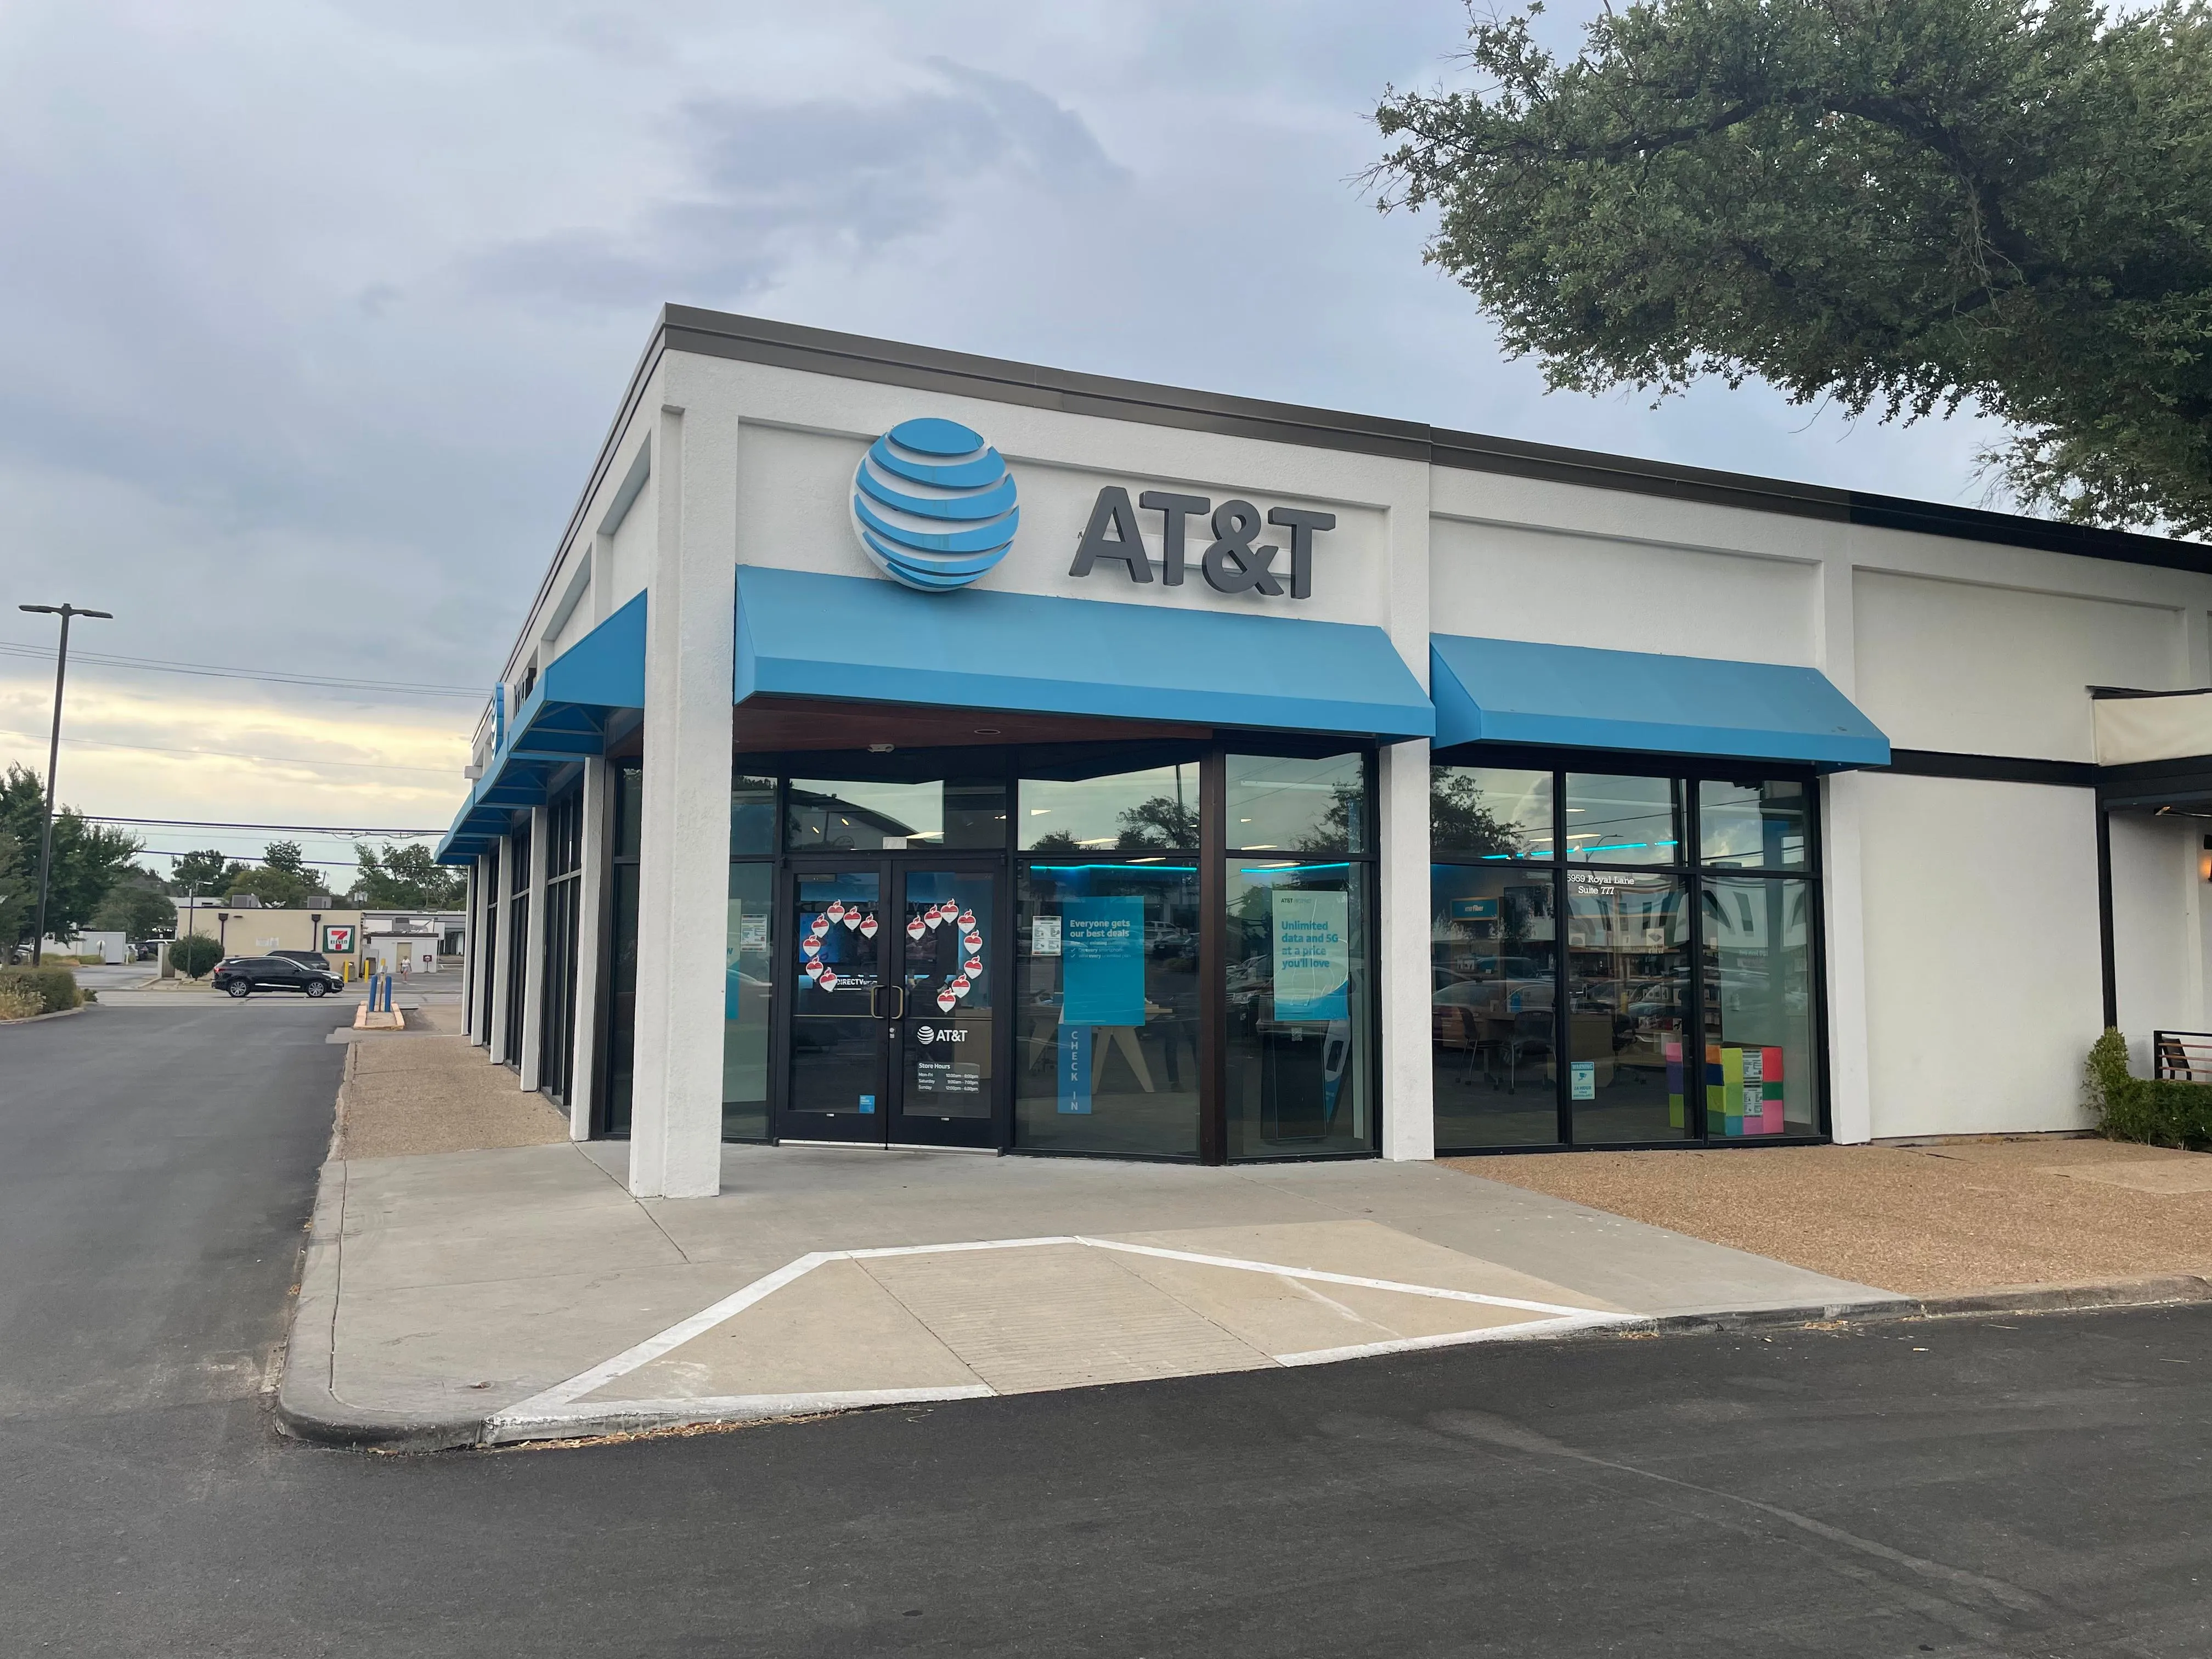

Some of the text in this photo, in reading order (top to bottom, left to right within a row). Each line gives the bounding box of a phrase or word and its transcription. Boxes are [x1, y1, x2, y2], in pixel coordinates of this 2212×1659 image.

[1069, 486, 1336, 599] AT&T
[1587, 875, 1611, 885] Royal
[1614, 876, 1634, 885] Lane
[1578, 885, 1615, 895] Suite 777
[1070, 919, 1130, 929] Everyone gets
[1282, 921, 1328, 930] Unlimited
[1107, 929, 1130, 937] deals
[1282, 933, 1339, 943] data and 5G
[1282, 947, 1292, 955] at
[1302, 945, 1326, 957] price
[1282, 958, 1330, 970] you'll love
[936, 1029, 968, 1042] AT&T
[1071, 1091, 1078, 1110] IN
